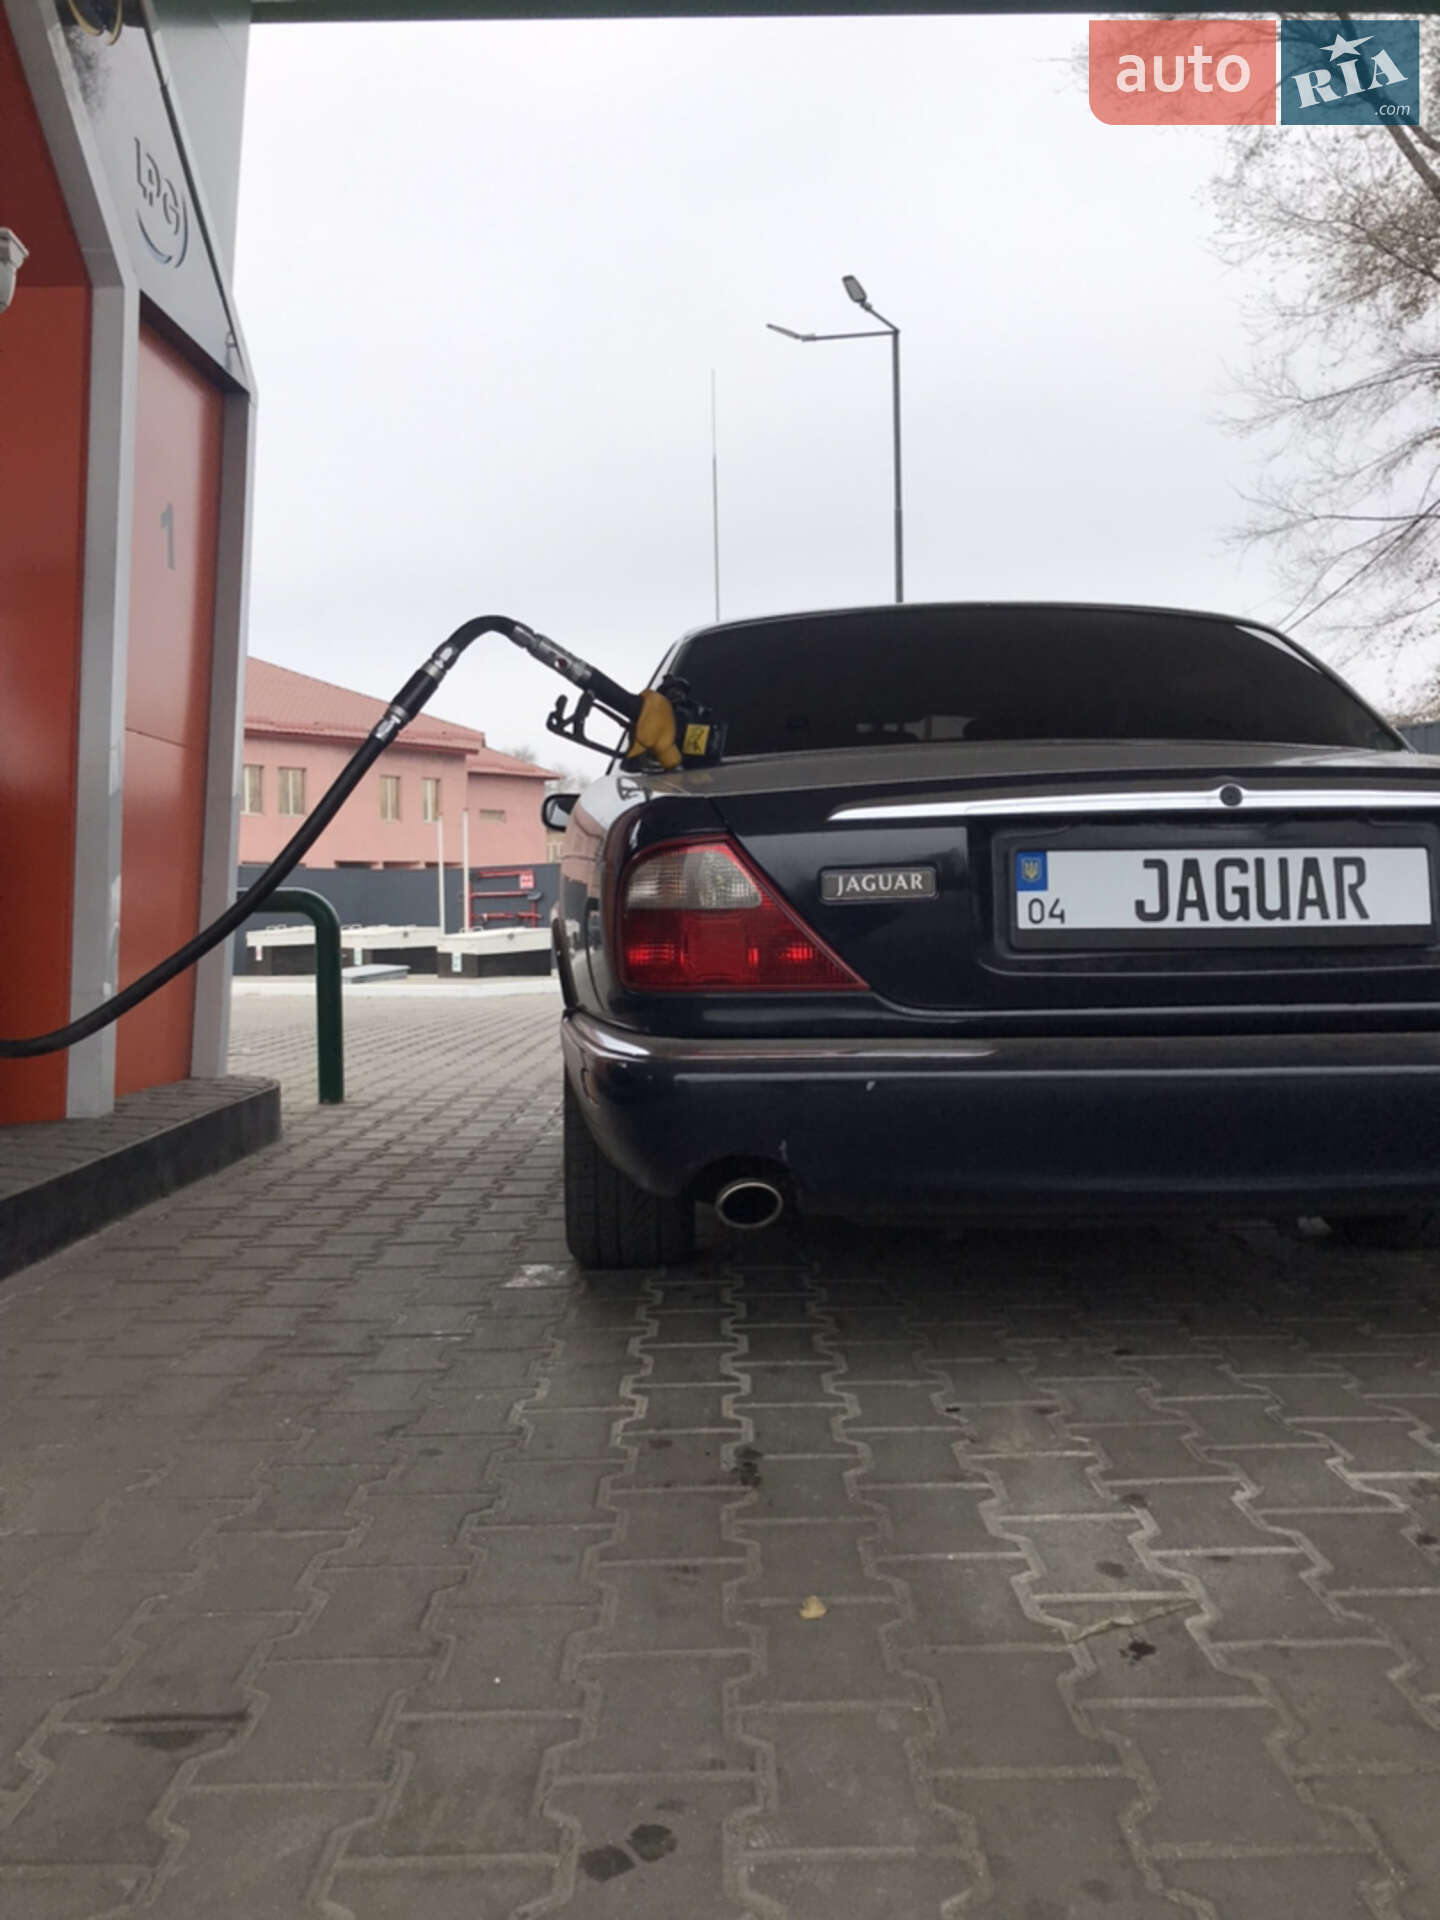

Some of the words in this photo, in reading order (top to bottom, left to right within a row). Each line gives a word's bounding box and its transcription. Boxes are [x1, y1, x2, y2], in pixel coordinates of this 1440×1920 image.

[160, 502, 175, 570] 1
[836, 873, 923, 897] JAGUAR
[1134, 856, 1370, 922] JAGUAR
[1028, 897, 1066, 925] 04
